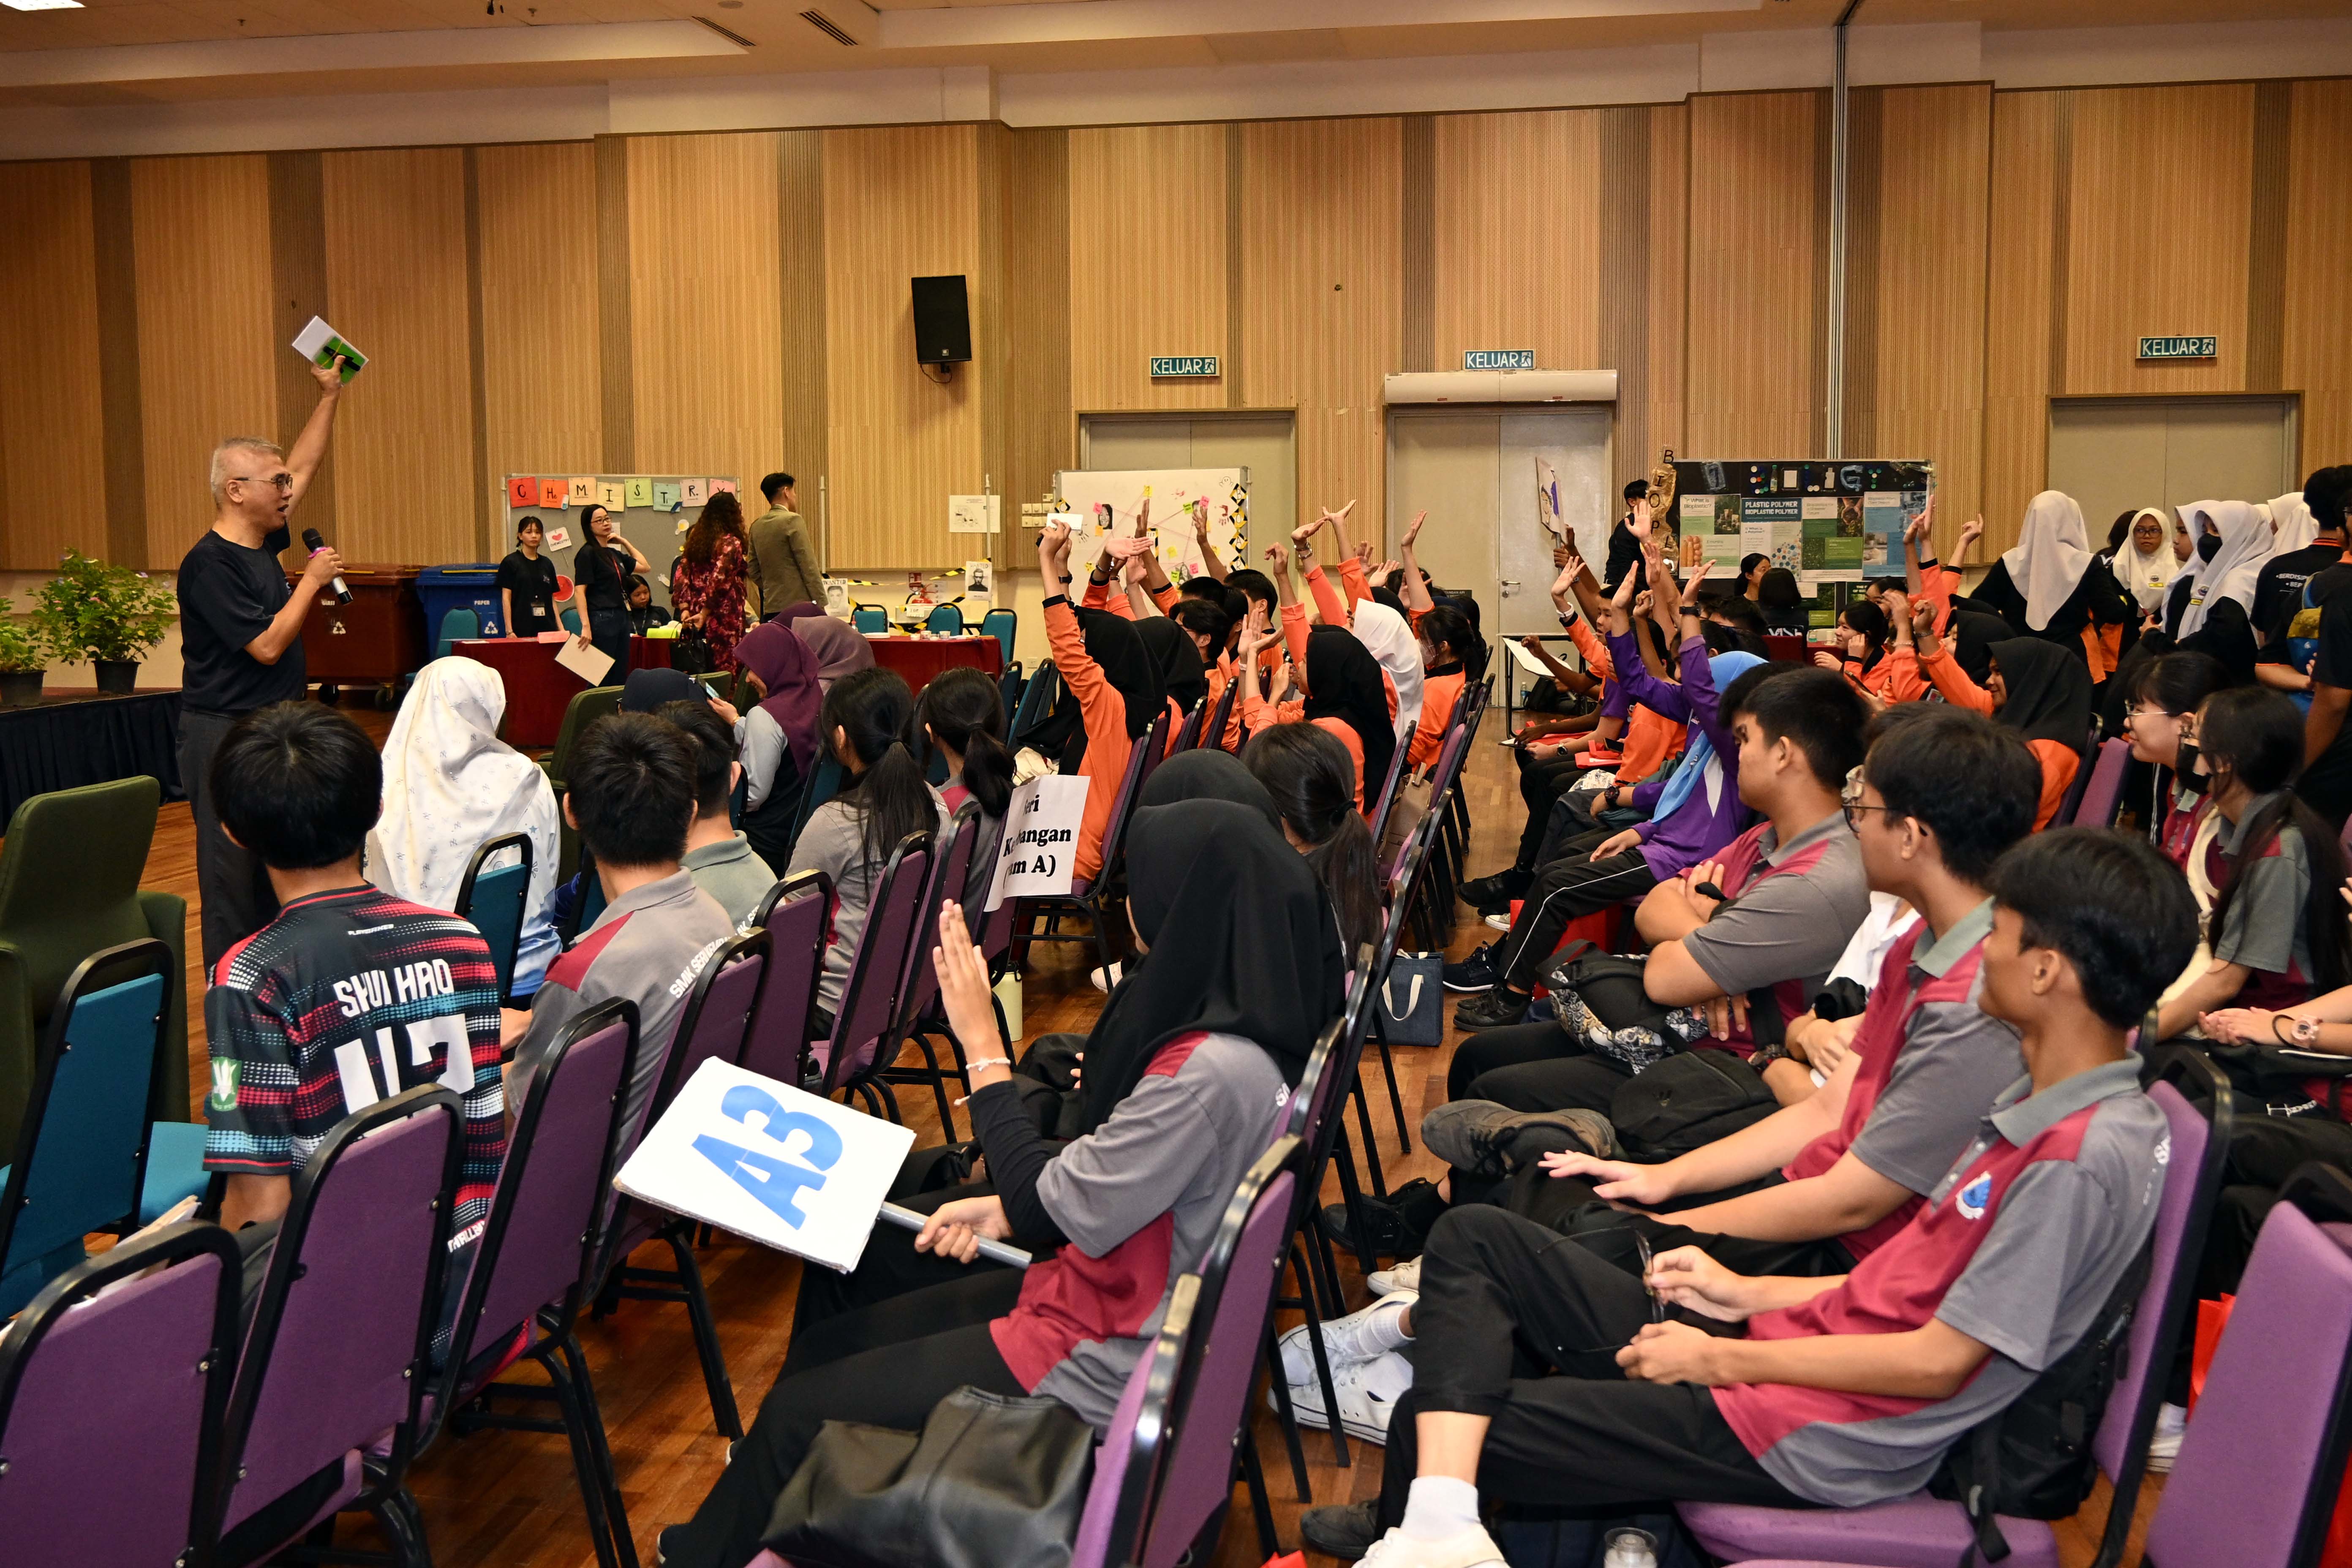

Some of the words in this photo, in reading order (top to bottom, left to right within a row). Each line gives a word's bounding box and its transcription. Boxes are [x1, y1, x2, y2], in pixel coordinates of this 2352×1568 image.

[2142, 339, 2199, 355] KELUAR
[1153, 359, 1202, 374] KELUAR
[1467, 352, 1519, 368] KELUAR
[1031, 855, 1056, 877] A)
[394, 958, 455, 1004] HAO
[670, 966, 696, 998] SMK
[691, 1085, 843, 1230] A3
